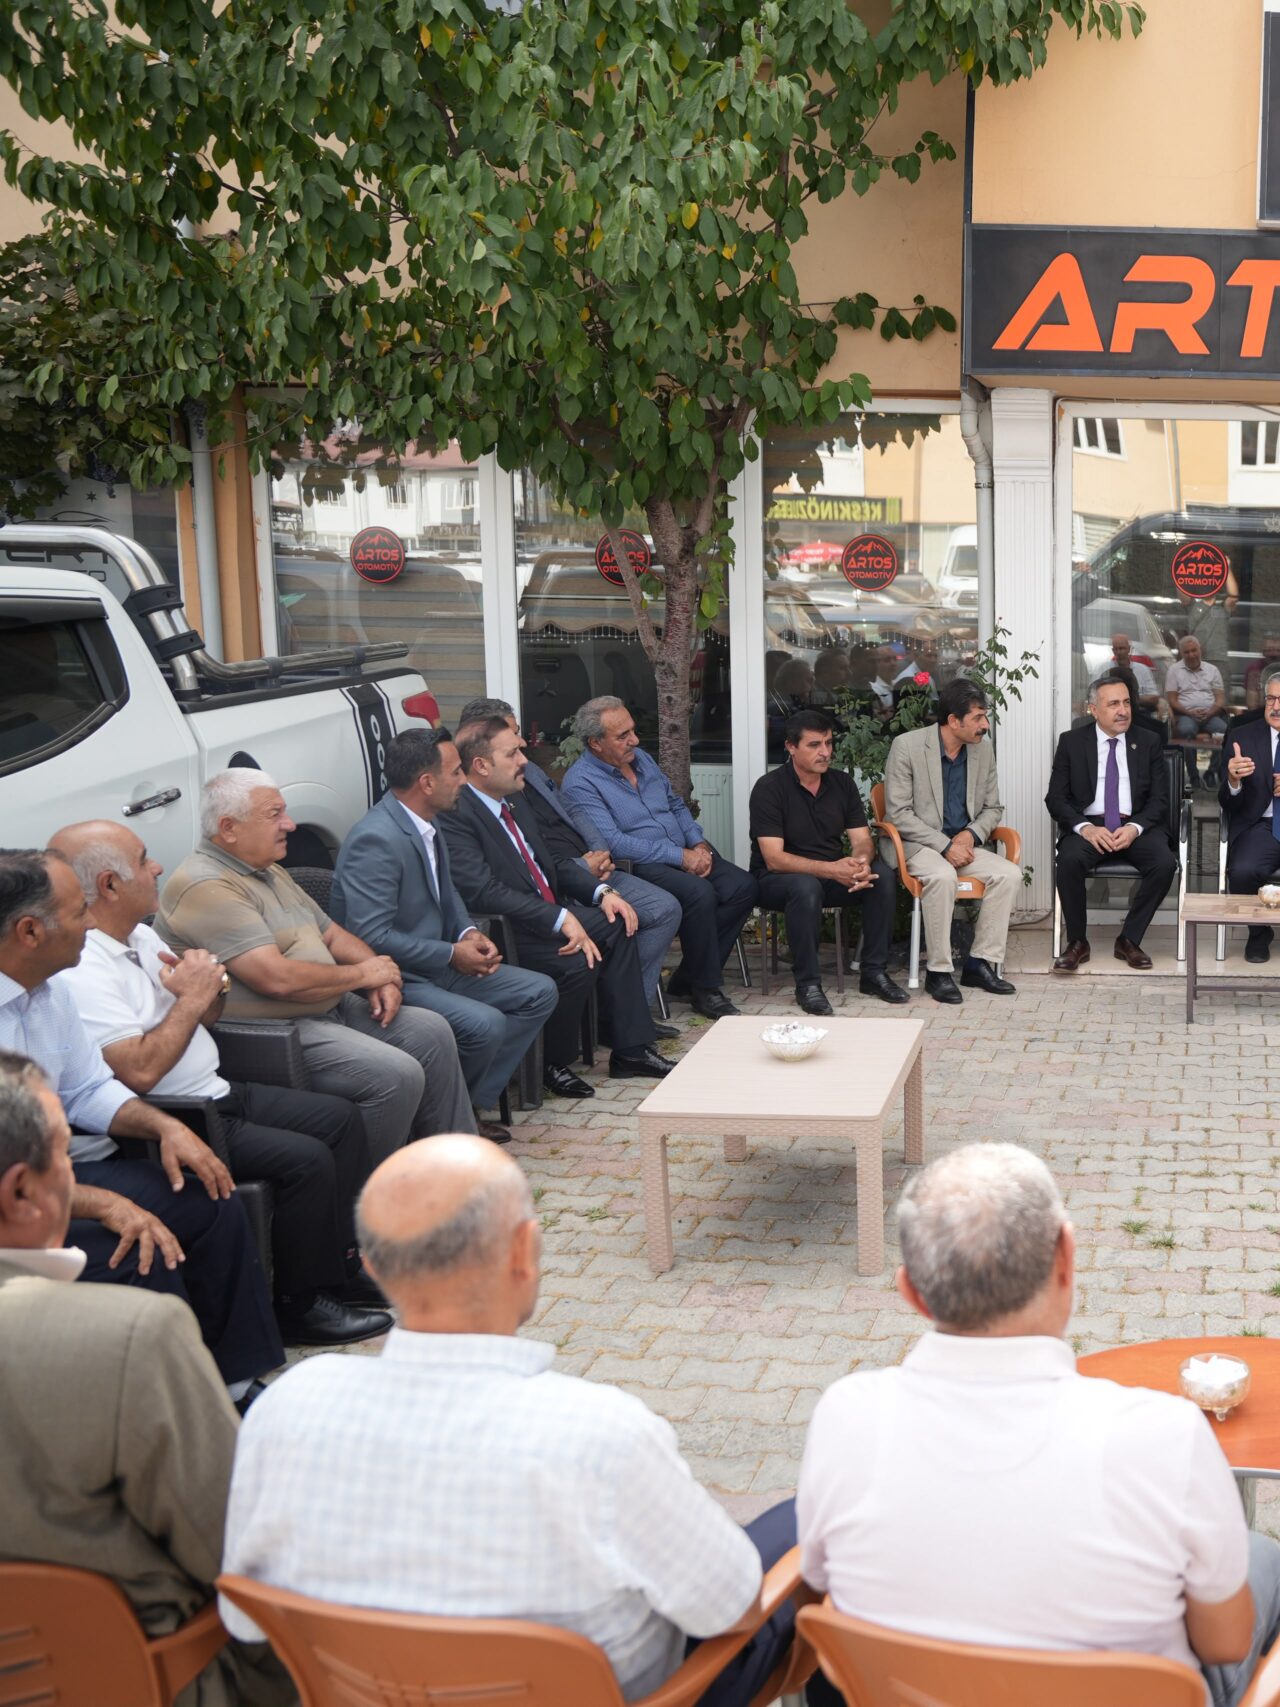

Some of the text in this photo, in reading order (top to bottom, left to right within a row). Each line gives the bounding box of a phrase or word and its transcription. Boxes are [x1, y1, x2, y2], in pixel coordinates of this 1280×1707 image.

[355, 548, 400, 561] ARTOS
[601, 551, 645, 563] AOS
[847, 557, 893, 569] ARTOS
[1176, 563, 1222, 576] ARTOS
